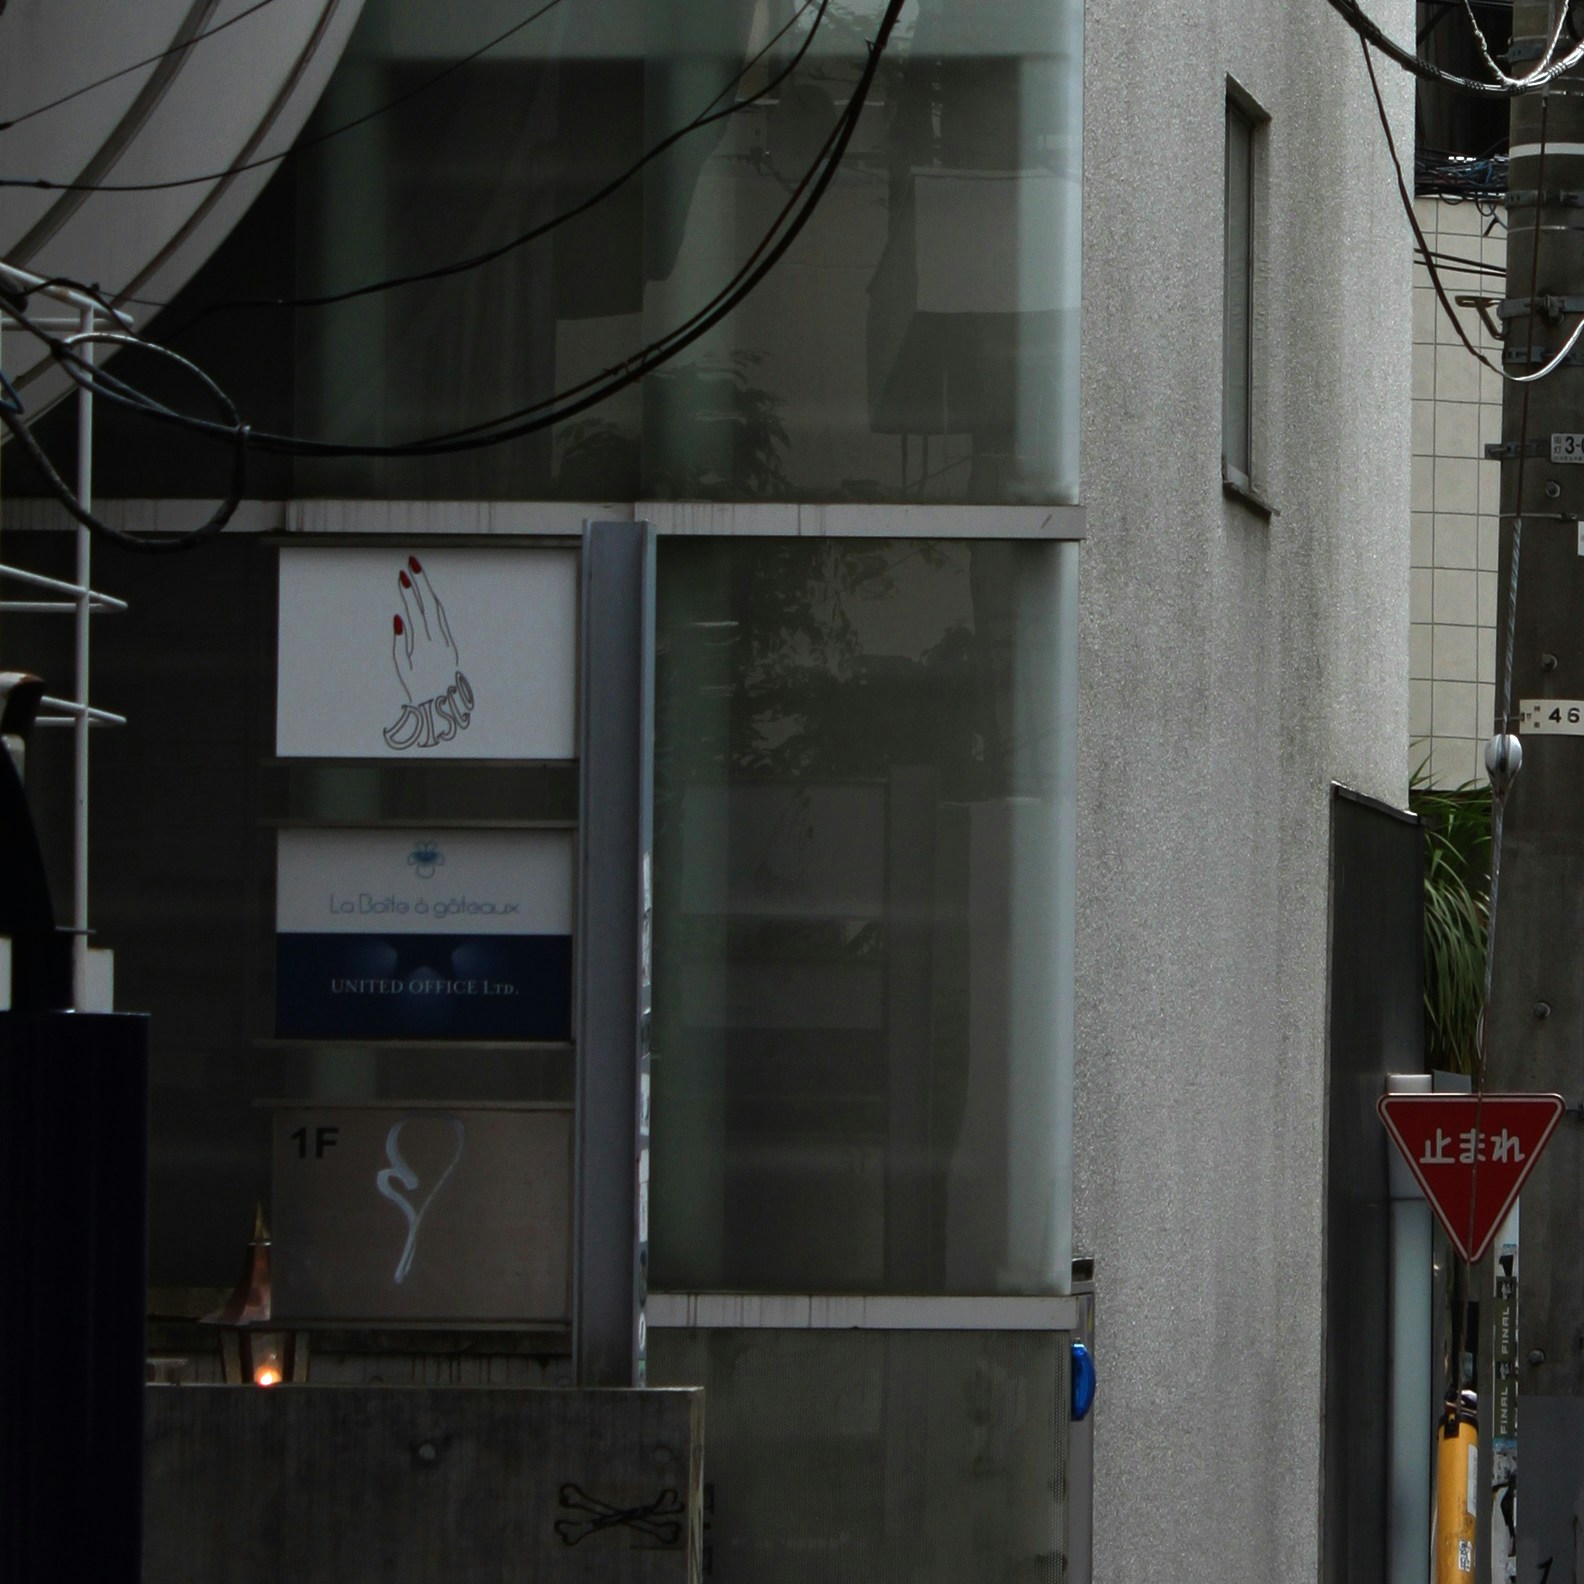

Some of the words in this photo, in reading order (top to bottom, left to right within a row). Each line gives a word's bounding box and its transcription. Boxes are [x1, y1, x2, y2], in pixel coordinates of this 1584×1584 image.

[383, 670, 476, 751] DISCO
[1548, 707, 1580, 723] 46
[329, 892, 355, 914] La
[359, 892, 410, 915] Boîte
[433, 894, 521, 920] gâteaux
[330, 977, 404, 995] UNITED
[408, 977, 478, 995] OFFICE
[290, 1127, 339, 1161] 1F
[1419, 1129, 1527, 1165] 止まれ
[1500, 1306, 1511, 1354] FINAL
[1499, 1386, 1510, 1435] FINAL
